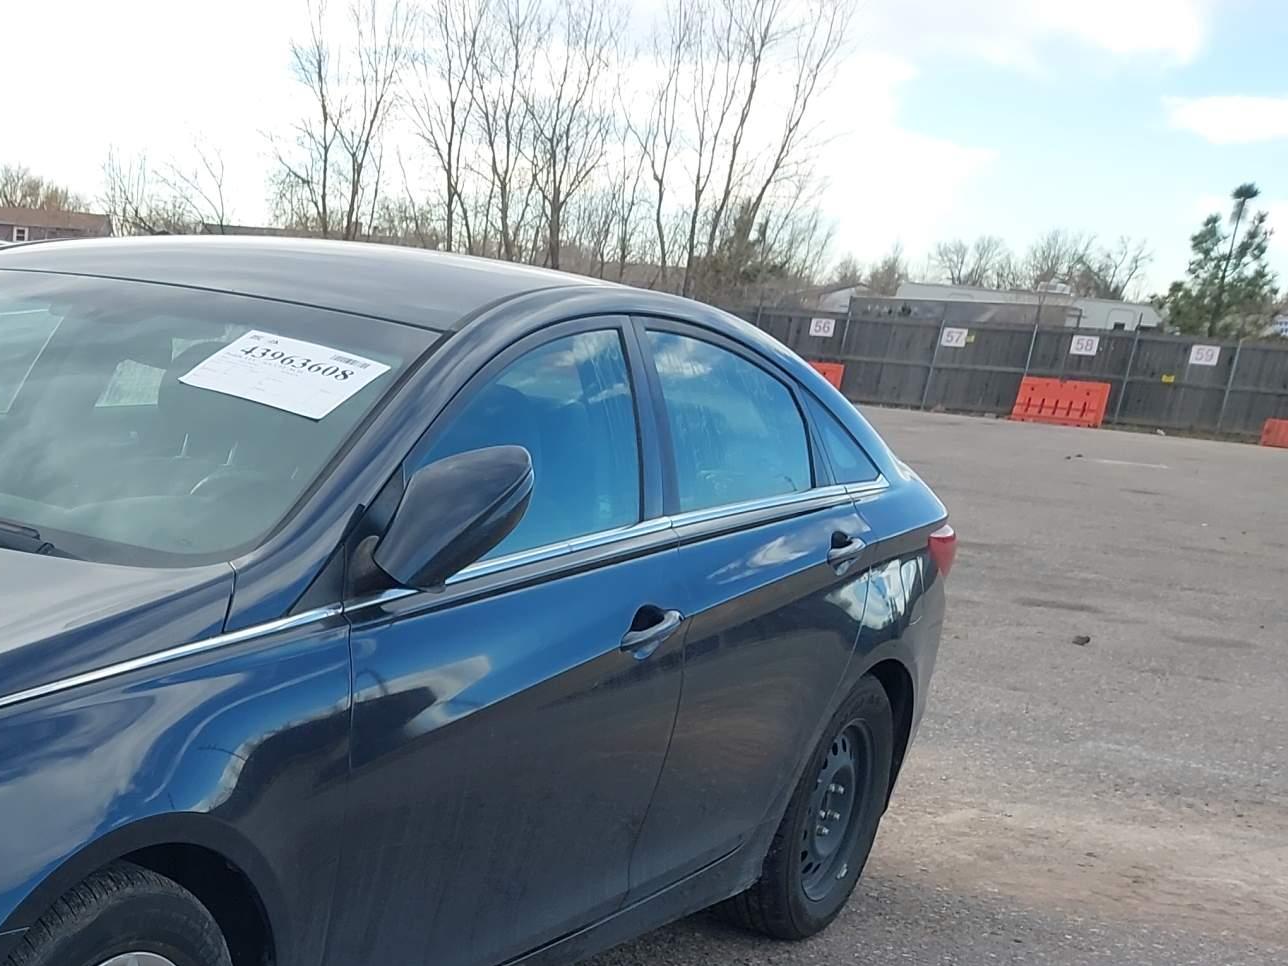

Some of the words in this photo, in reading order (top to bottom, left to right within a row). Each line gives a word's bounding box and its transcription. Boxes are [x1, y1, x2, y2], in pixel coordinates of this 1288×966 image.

[814, 321, 831, 334] 56
[945, 331, 963, 344] 57
[1075, 338, 1094, 352] 58
[1194, 348, 1215, 362] 59
[240, 345, 356, 382] 43963608
